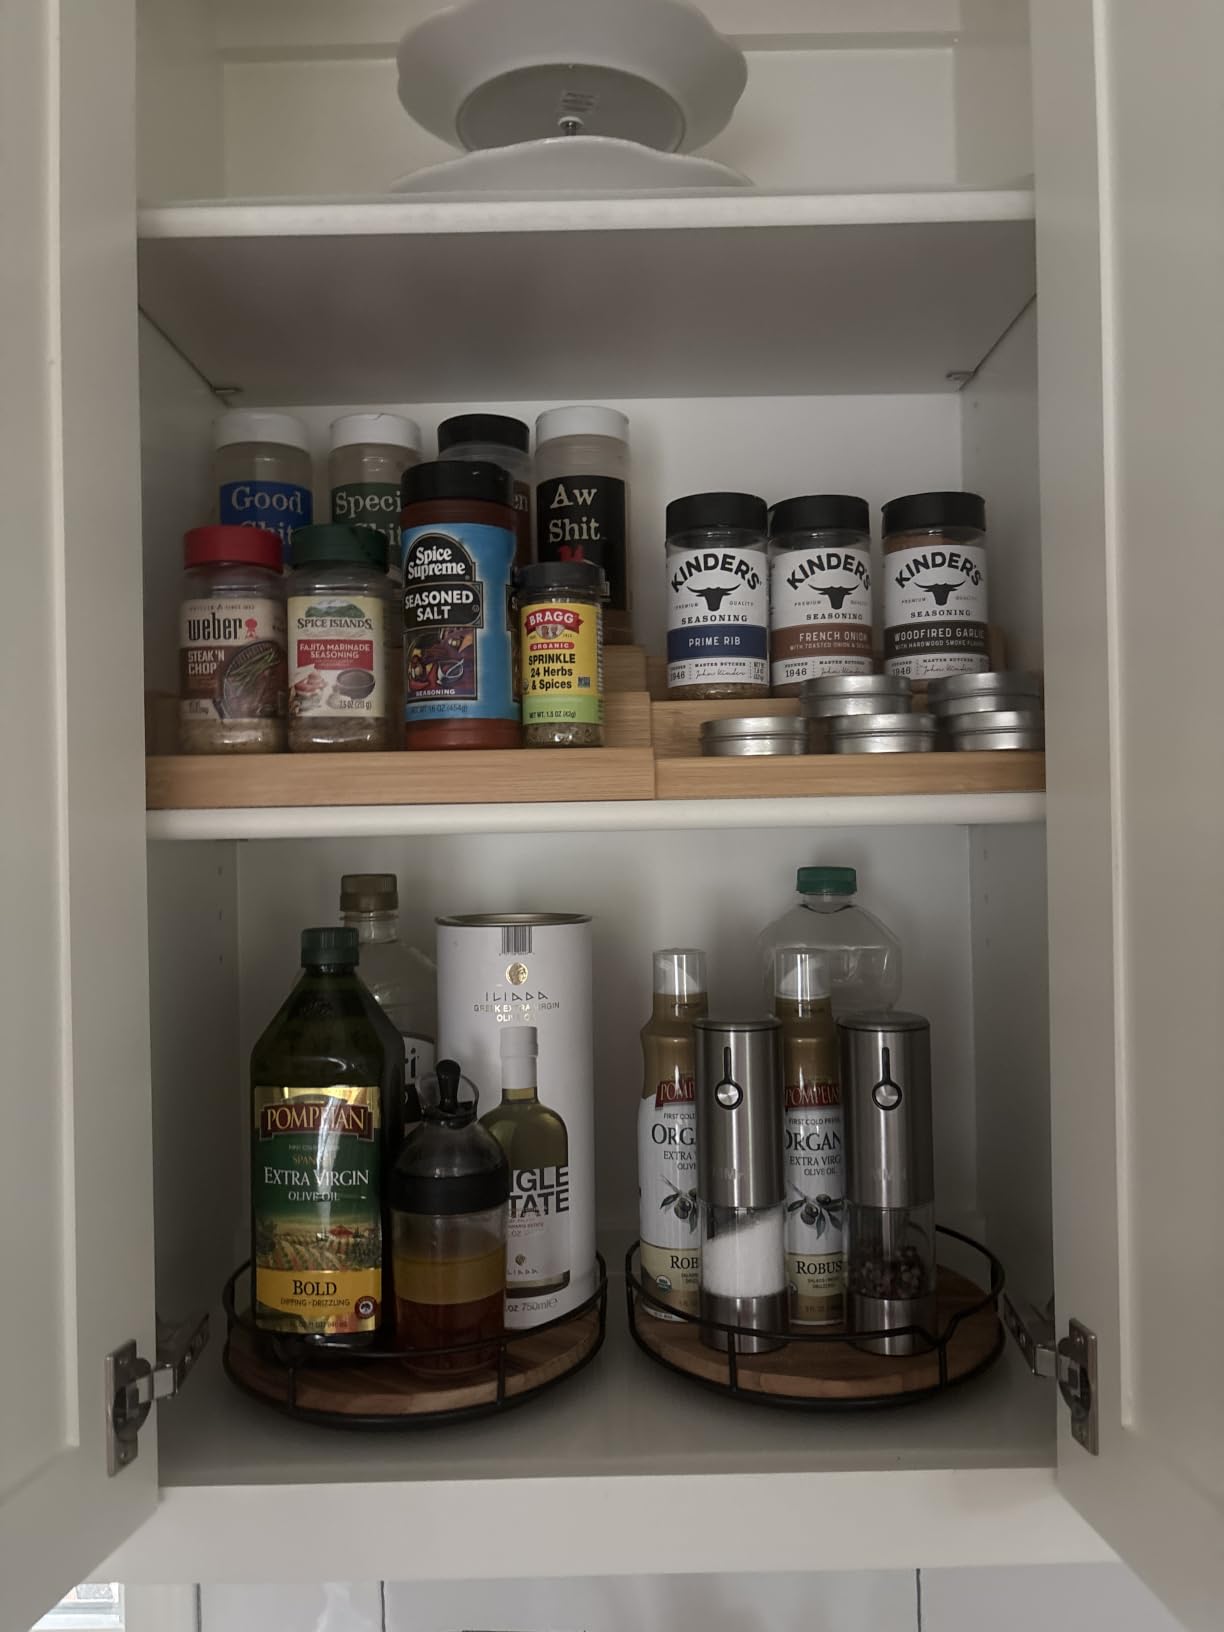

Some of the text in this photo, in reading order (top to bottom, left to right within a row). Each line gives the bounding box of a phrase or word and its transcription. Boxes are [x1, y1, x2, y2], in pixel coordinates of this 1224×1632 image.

[231, 486, 304, 514] Good
[550, 483, 599, 509] Aw
[549, 516, 600, 543] Shit
[415, 545, 453, 566] Spice
[407, 561, 466, 581] Supreme
[671, 553, 760, 593] KINDER'S
[786, 552, 871, 591] KINDER'S
[895, 551, 980, 589] KINDER'S
[404, 589, 474, 610] SEASONED
[417, 605, 452, 622] SALT
[529, 610, 574, 626] BRAGG
[681, 614, 748, 625] SEASONING
[806, 613, 863, 621] SEASONING
[910, 609, 972, 619] SEASONING
[187, 612, 242, 641] weber
[297, 618, 328, 630] SPICE
[330, 618, 374, 631] ISLANDS
[799, 631, 841, 643] FRENCH
[894, 628, 952, 642] WOODFIRED
[300, 643, 371, 652] FAJITA MARINADE
[688, 636, 741, 648] PRIME RIB
[908, 640, 944, 649] HARDWOOD
[310, 650, 360, 659] SEASONING
[528, 653, 577, 666] SPRINKLE
[188, 661, 217, 674] CHOP
[530, 666, 574, 679] 24 Herbs
[785, 668, 807, 678] 1946
[531, 680, 537, 690] &
[539, 679, 573, 692] Spices
[415, 689, 456, 697] SEASONING
[267, 1105, 365, 1130] POMPIAN
[663, 1112, 679, 1120] FIRST
[804, 1118, 824, 1126] COLD
[663, 1150, 692, 1161] EXTRA
[790, 1155, 820, 1167] EXTRA
[263, 1166, 369, 1186] EXTRA VIRGIN
[803, 1168, 826, 1176] OLIVE
[509, 1166, 570, 1192] GLE
[288, 1191, 320, 1201] OLIVE
[292, 1279, 337, 1296] BOLD
